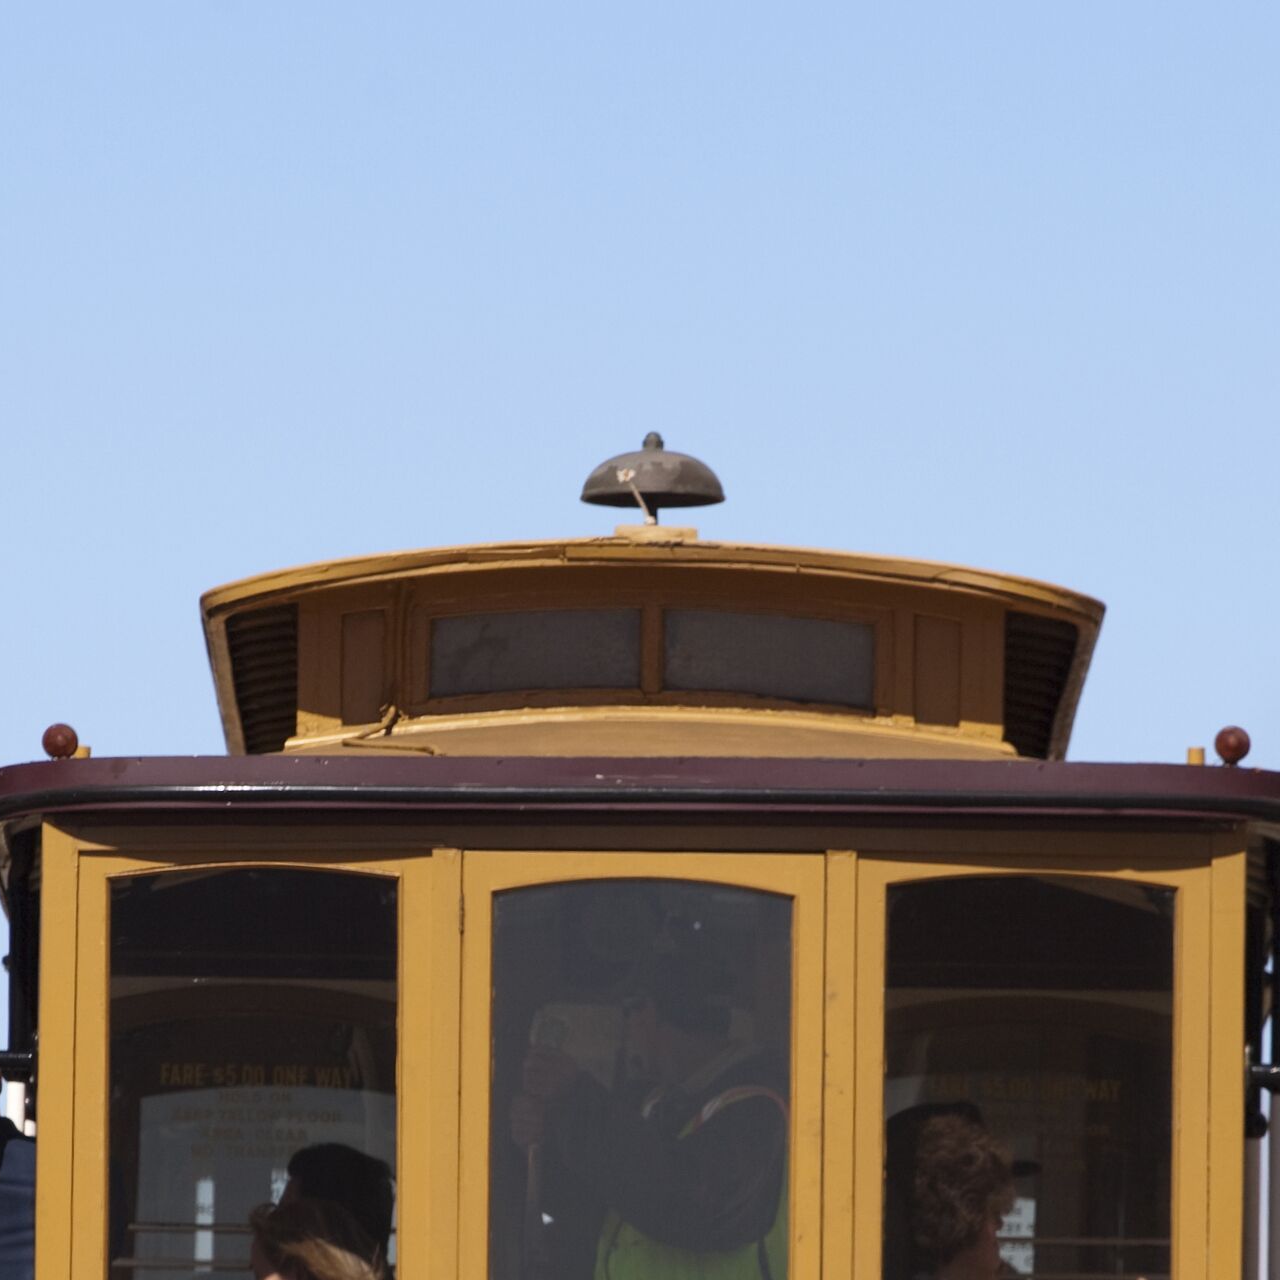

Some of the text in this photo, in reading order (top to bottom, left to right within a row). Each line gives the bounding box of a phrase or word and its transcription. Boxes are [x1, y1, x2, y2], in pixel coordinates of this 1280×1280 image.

[160, 1062, 207, 1086] FARE
[272, 1063, 308, 1087] ONE
[313, 1064, 351, 1090] WAY
